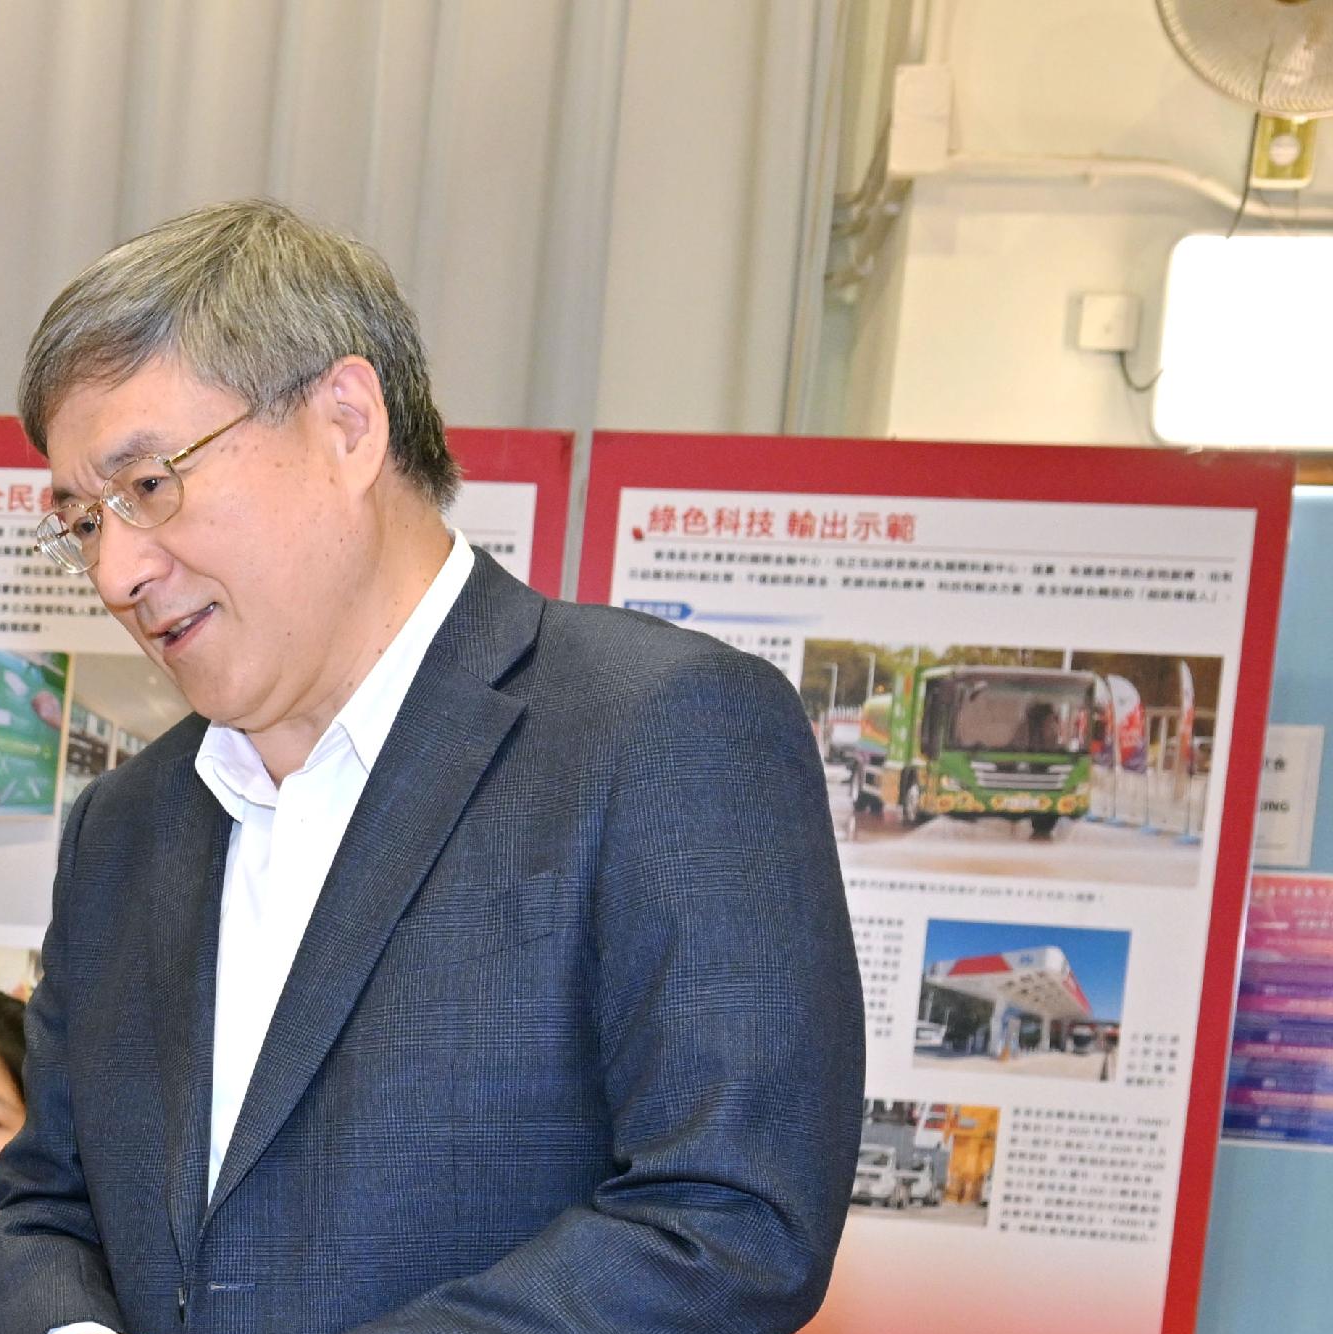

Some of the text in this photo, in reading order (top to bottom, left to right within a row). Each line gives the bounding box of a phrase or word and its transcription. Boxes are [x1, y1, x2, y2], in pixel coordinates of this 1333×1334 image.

[647, 504, 917, 543] 綠色科技 輸出示範
